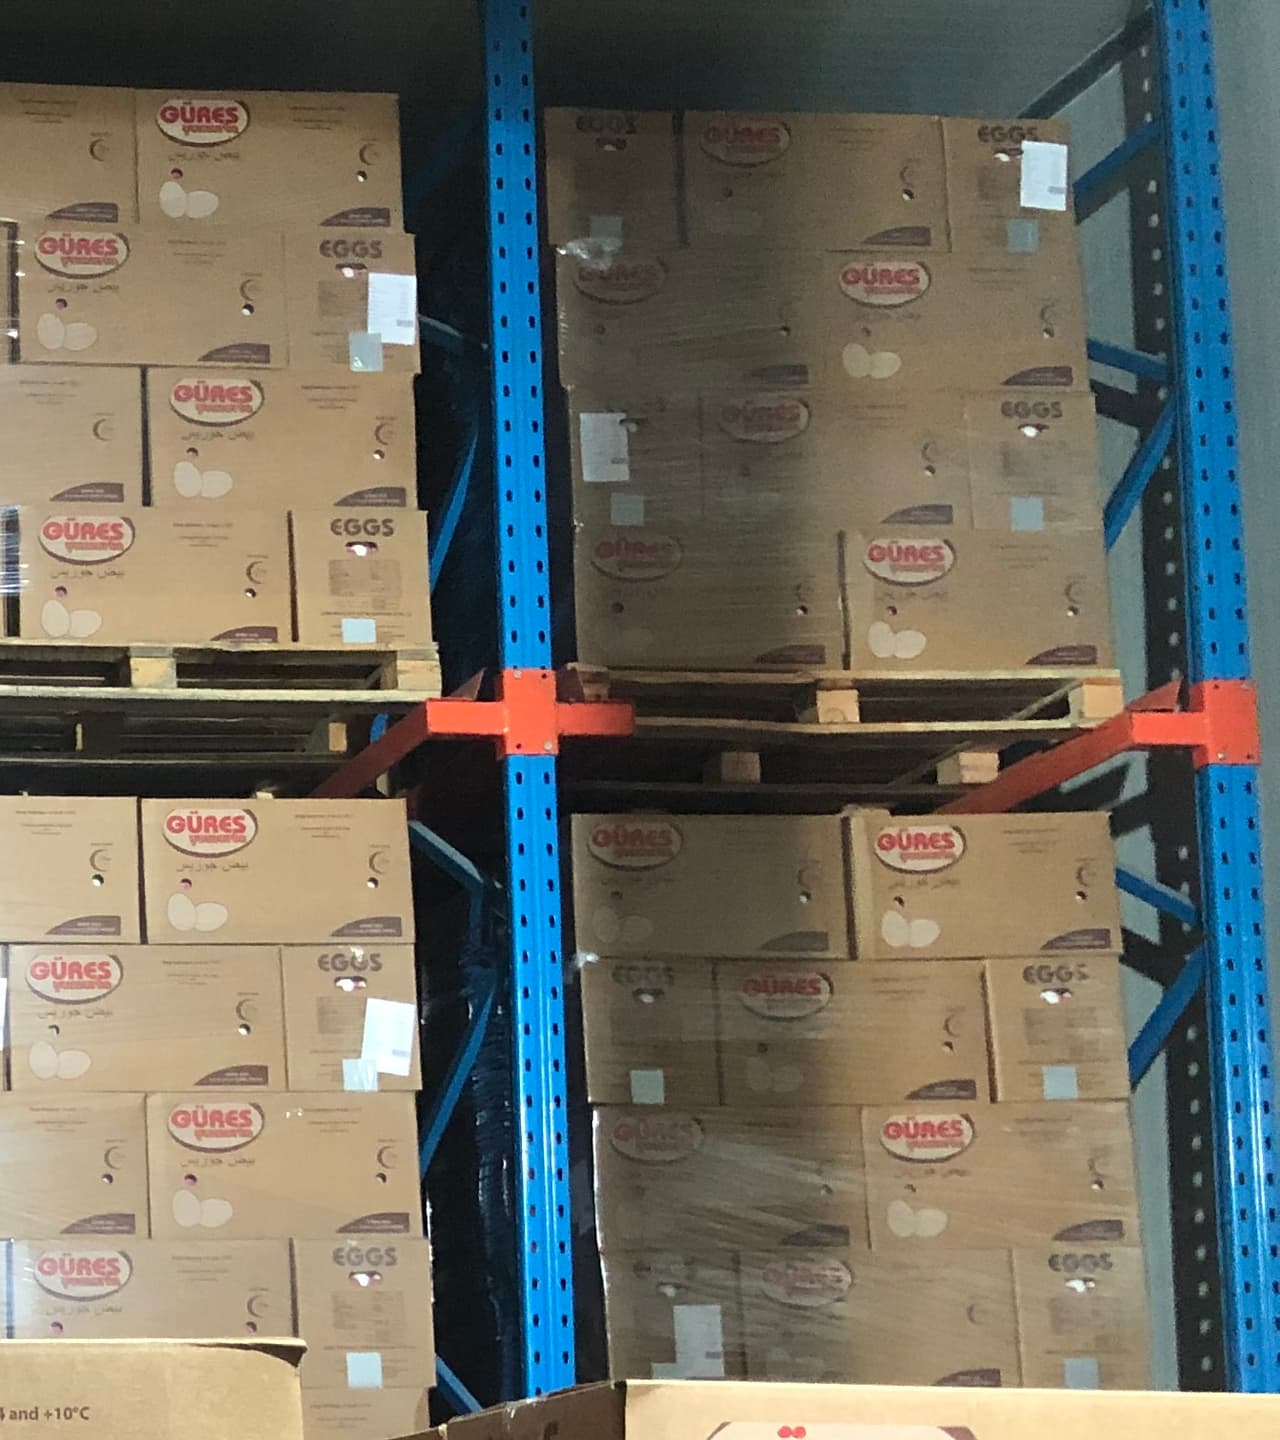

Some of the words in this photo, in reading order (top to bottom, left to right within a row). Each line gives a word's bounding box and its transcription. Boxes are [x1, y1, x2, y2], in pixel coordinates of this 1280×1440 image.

[160, 100, 240, 127] GÜRES
[320, 240, 382, 259] EGGS
[842, 260, 921, 286] GÜRES
[330, 518, 393, 537] EGGS
[869, 539, 948, 564] GÜRES
[166, 810, 247, 837] GÜRES
[877, 826, 955, 852] GÜRES
[171, 1103, 253, 1131] GÜRES
[884, 1115, 963, 1141] GÜRES
[10, 1407, 38, 1420] and
[44, 1406, 90, 1420] +10°C
